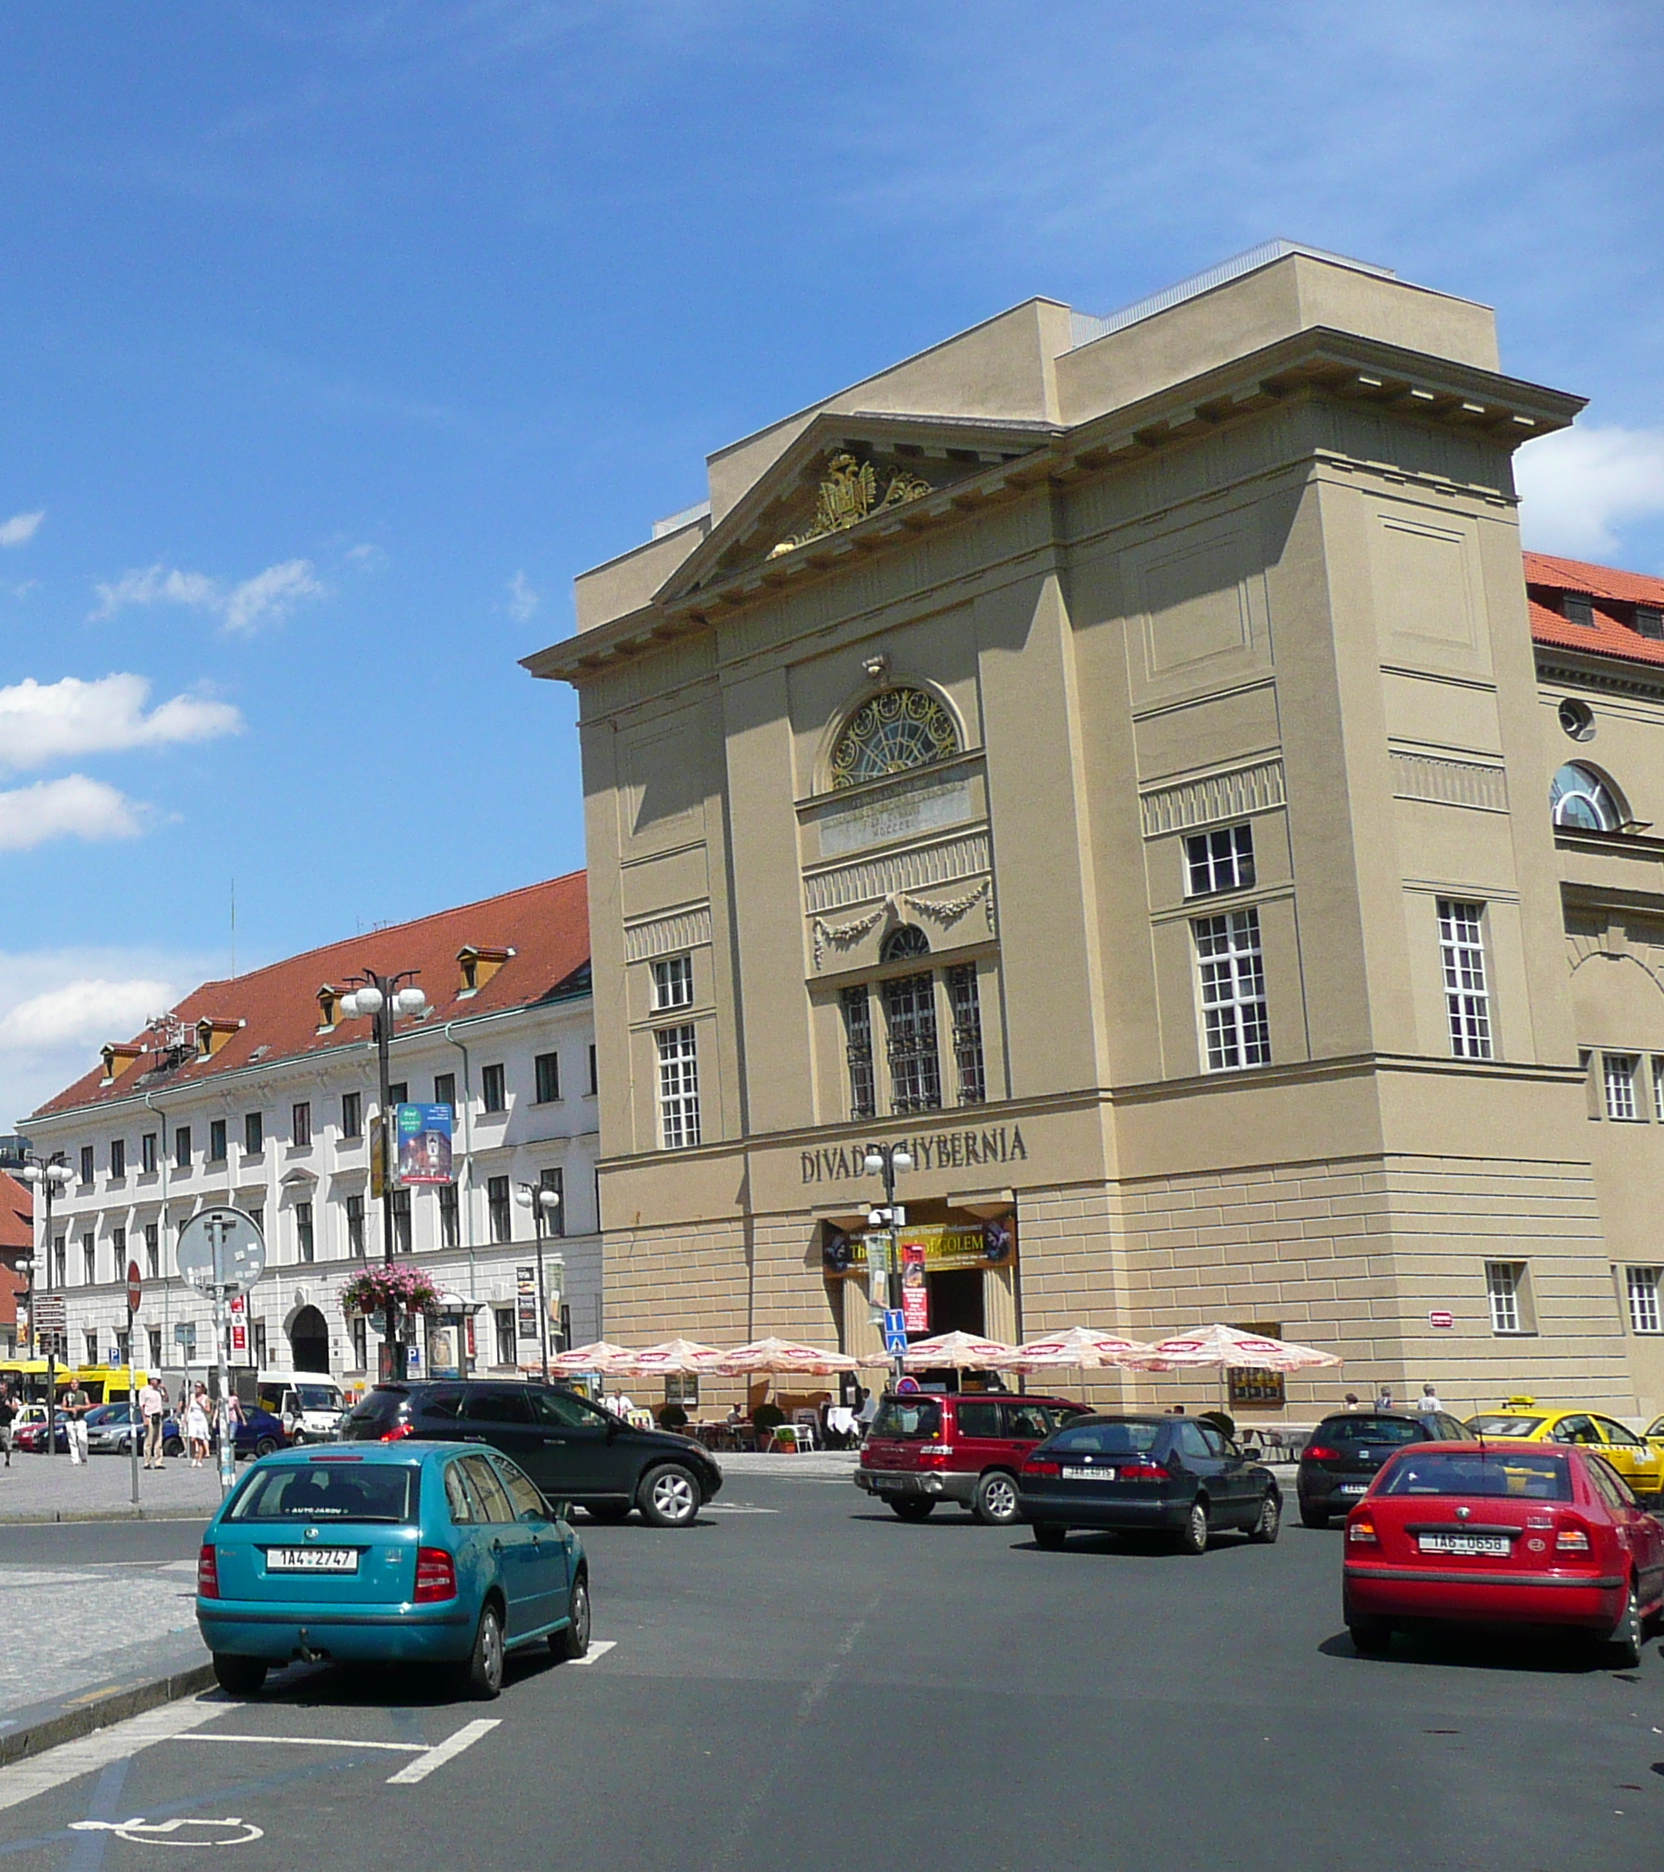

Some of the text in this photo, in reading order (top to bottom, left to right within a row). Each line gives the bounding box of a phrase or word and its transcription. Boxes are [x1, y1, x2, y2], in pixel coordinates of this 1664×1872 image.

[938, 1234, 984, 1253] GOLEM
[111, 1349, 118, 1361] P
[409, 1349, 417, 1362] P
[1432, 1535, 1456, 1548] 1A6
[280, 1551, 350, 1566] 1A4 2747
